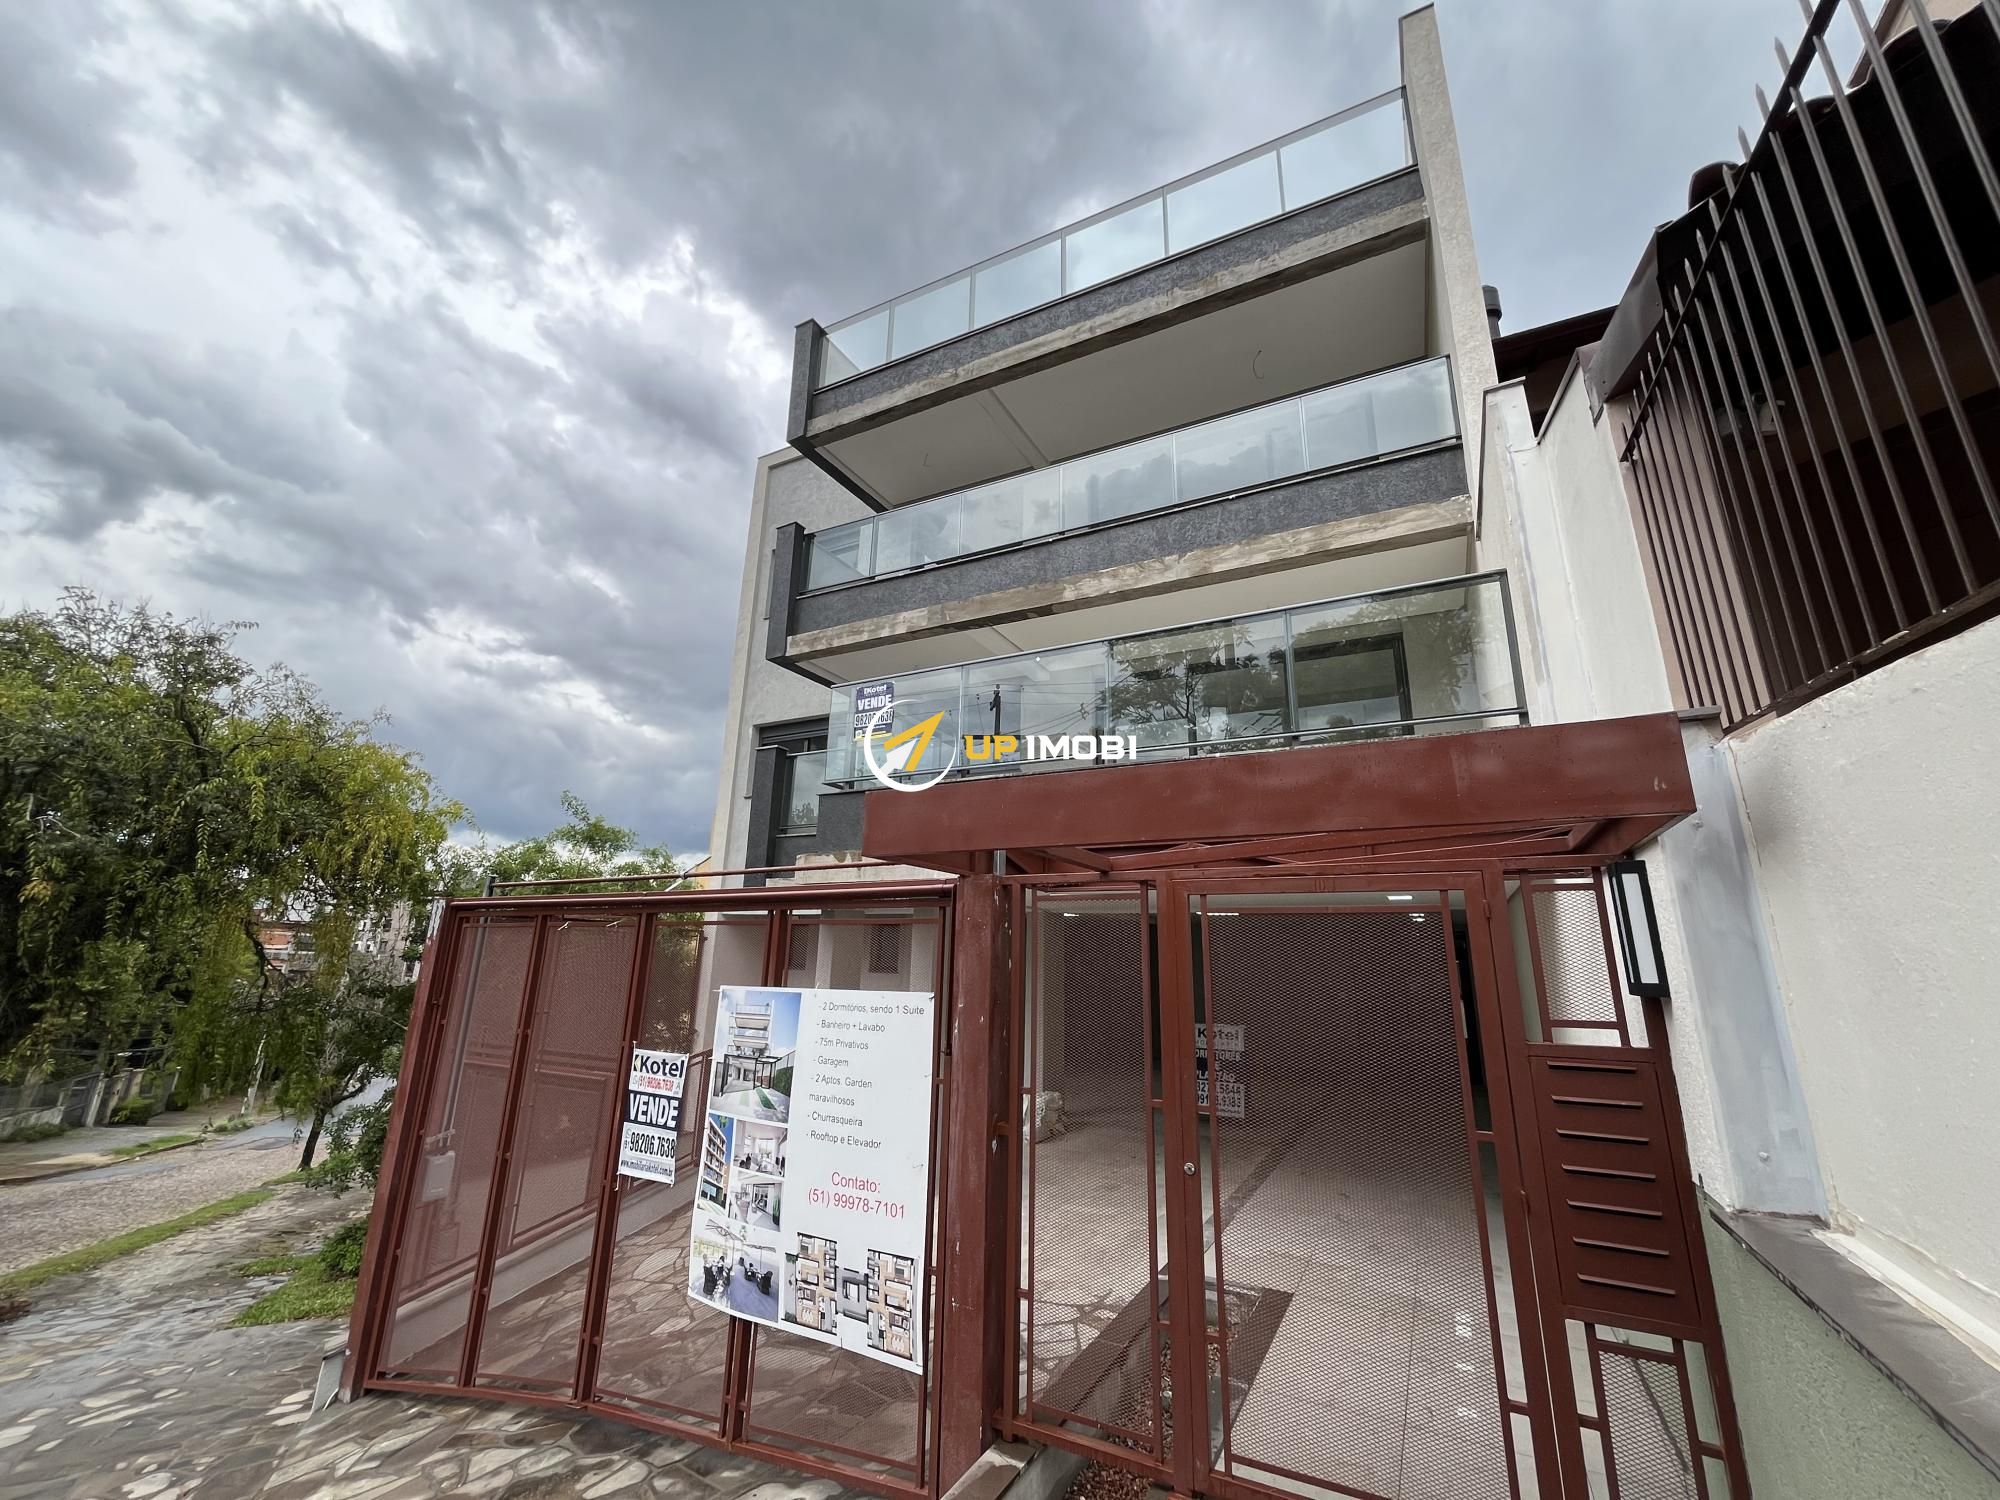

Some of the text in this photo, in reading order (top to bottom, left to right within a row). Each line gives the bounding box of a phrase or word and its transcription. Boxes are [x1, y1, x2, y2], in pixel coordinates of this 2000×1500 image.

[857, 694, 892, 711] VENDE
[822, 1002, 827, 1011] 2
[870, 1004, 893, 1014] sendo
[821, 1019, 851, 1030] Banheiro
[858, 1022, 886, 1032] Lavabo
[835, 1039, 869, 1050] Privativos
[639, 1055, 685, 1079] Kotel
[817, 1056, 849, 1068] Garagem
[815, 1074, 821, 1083] 2
[844, 1077, 873, 1088] Garden
[808, 1093, 855, 1106] maravilhosos
[629, 1092, 679, 1128] VENDE
[811, 1111, 863, 1127] Churrasqueira
[630, 1131, 676, 1159] 98206.7638
[810, 1130, 839, 1144] Rooftop
[847, 1136, 882, 1149] Elevador
[831, 1172, 881, 1193] Contato:
[808, 1187, 905, 1219] (51) 99978-7101
